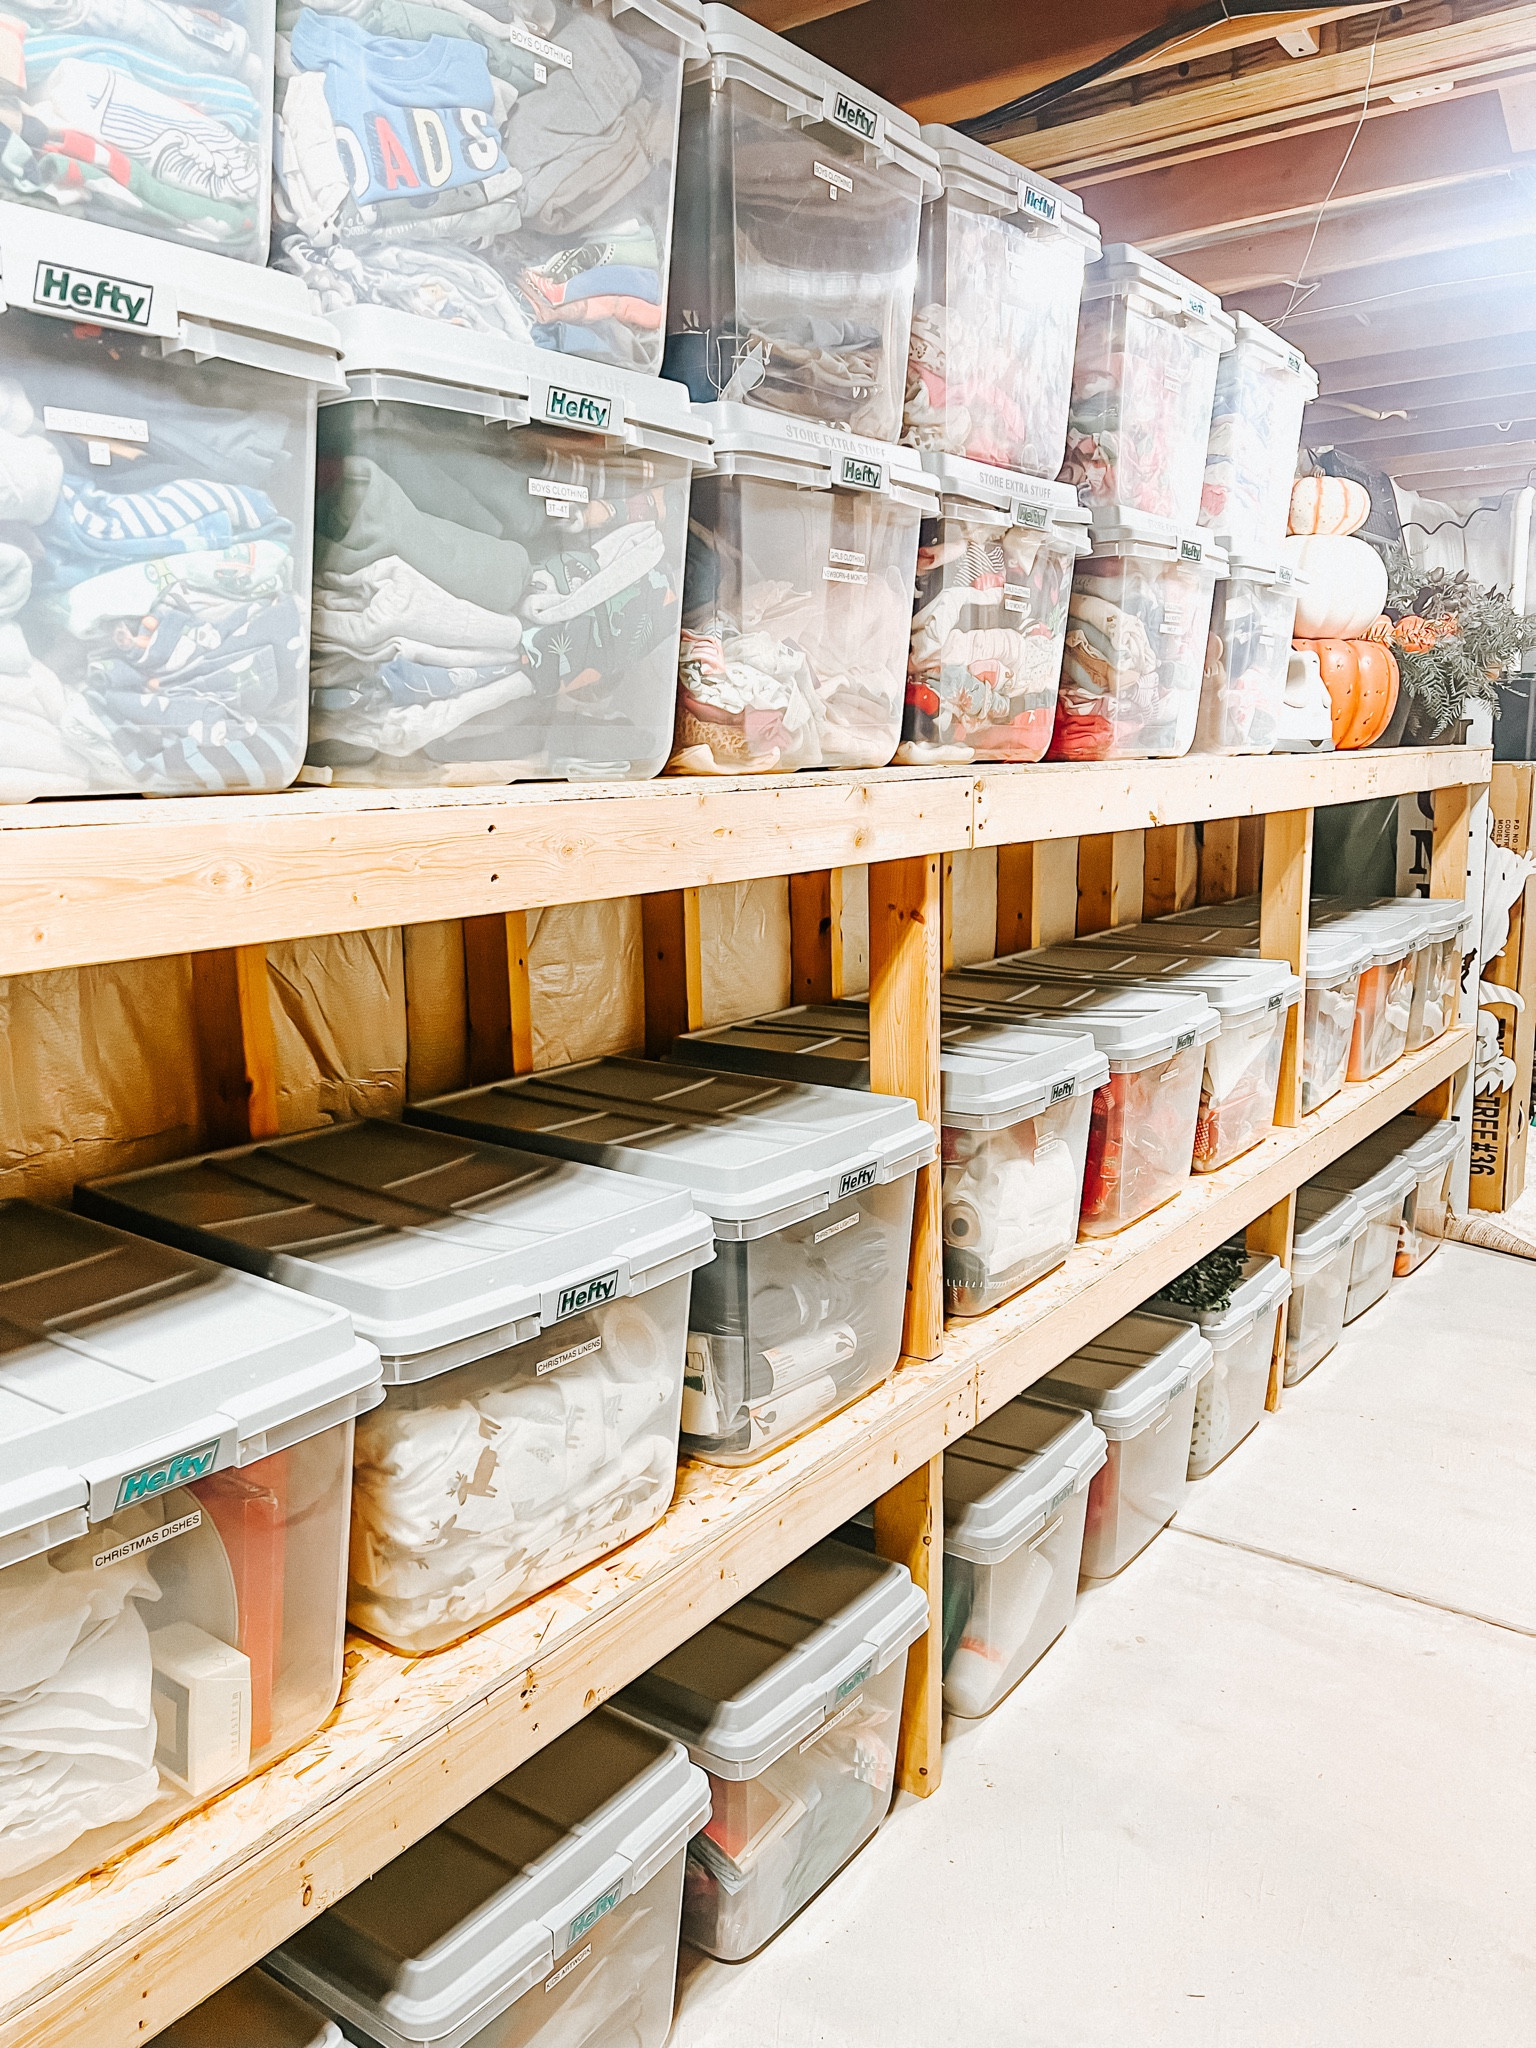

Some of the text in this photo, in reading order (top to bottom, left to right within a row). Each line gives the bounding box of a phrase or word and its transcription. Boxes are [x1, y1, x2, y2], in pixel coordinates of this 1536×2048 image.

[512, 29, 571, 64] BOYS CLOTHING
[837, 97, 874, 136] Hefty
[828, 171, 852, 189] CLOTHING
[1026, 190, 1054, 218] Hefty
[43, 268, 145, 322] Hefty
[551, 390, 607, 426] Hefty
[785, 424, 885, 458] STORE EXTRA STUFF
[531, 482, 588, 500] BOYS CLOTHING
[845, 461, 879, 487] Hefty
[979, 471, 1051, 499] STORE EXTRA STUFF
[1019, 505, 1046, 526] Hefty
[1182, 542, 1200, 560] Hefty
[1496, 819, 1504, 842] MODEL
[1052, 1082, 1074, 1099] Hefty
[1470, 1097, 1500, 1176] TREE #36
[841, 1169, 875, 1193] Hefty
[561, 1279, 614, 1314] Hefty
[537, 1338, 601, 1372] CHRISTMAS LINENS
[122, 1450, 213, 1503] Hefty
[94, 1514, 200, 1567] CHRISTMAS DISHES
[570, 1886, 620, 1942] Hefty
[545, 1947, 591, 1989] KIDS ARTWORK
